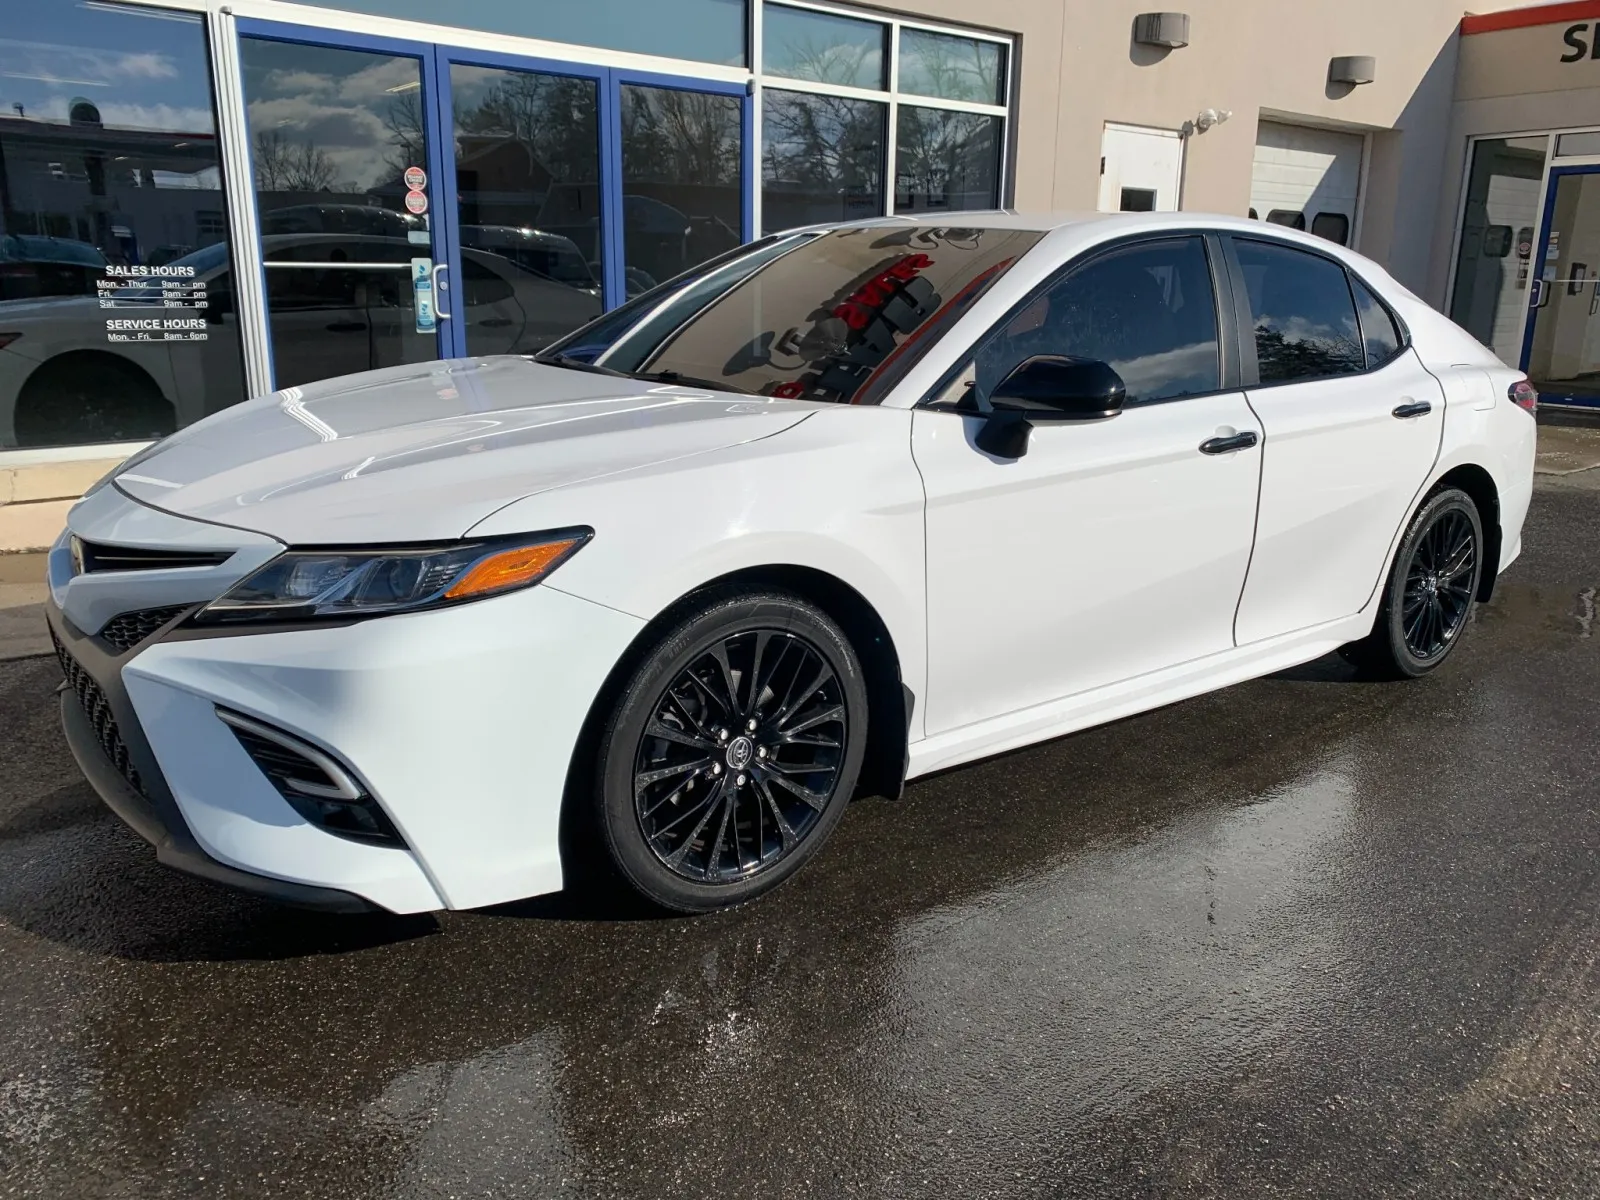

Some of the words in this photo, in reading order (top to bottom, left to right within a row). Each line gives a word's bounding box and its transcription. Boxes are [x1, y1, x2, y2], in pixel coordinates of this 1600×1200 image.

[105, 265, 149, 276] SALES
[150, 266, 195, 276] HOURS
[96, 280, 119, 289] Mon.
[127, 280, 149, 289] Thur.
[161, 280, 180, 289] 9am
[192, 281, 206, 289] pm
[98, 290, 113, 298] Fri.
[162, 290, 181, 298] 9am
[193, 291, 206, 299] pm
[99, 300, 117, 308] Sat.
[164, 300, 182, 308] 9am
[106, 319, 160, 329] SERVICE
[164, 319, 207, 329] HOURS
[107, 333, 129, 341] Mon.
[137, 332, 152, 340] Fri.
[163, 332, 183, 340] 8am
[190, 332, 208, 340] 6pm
